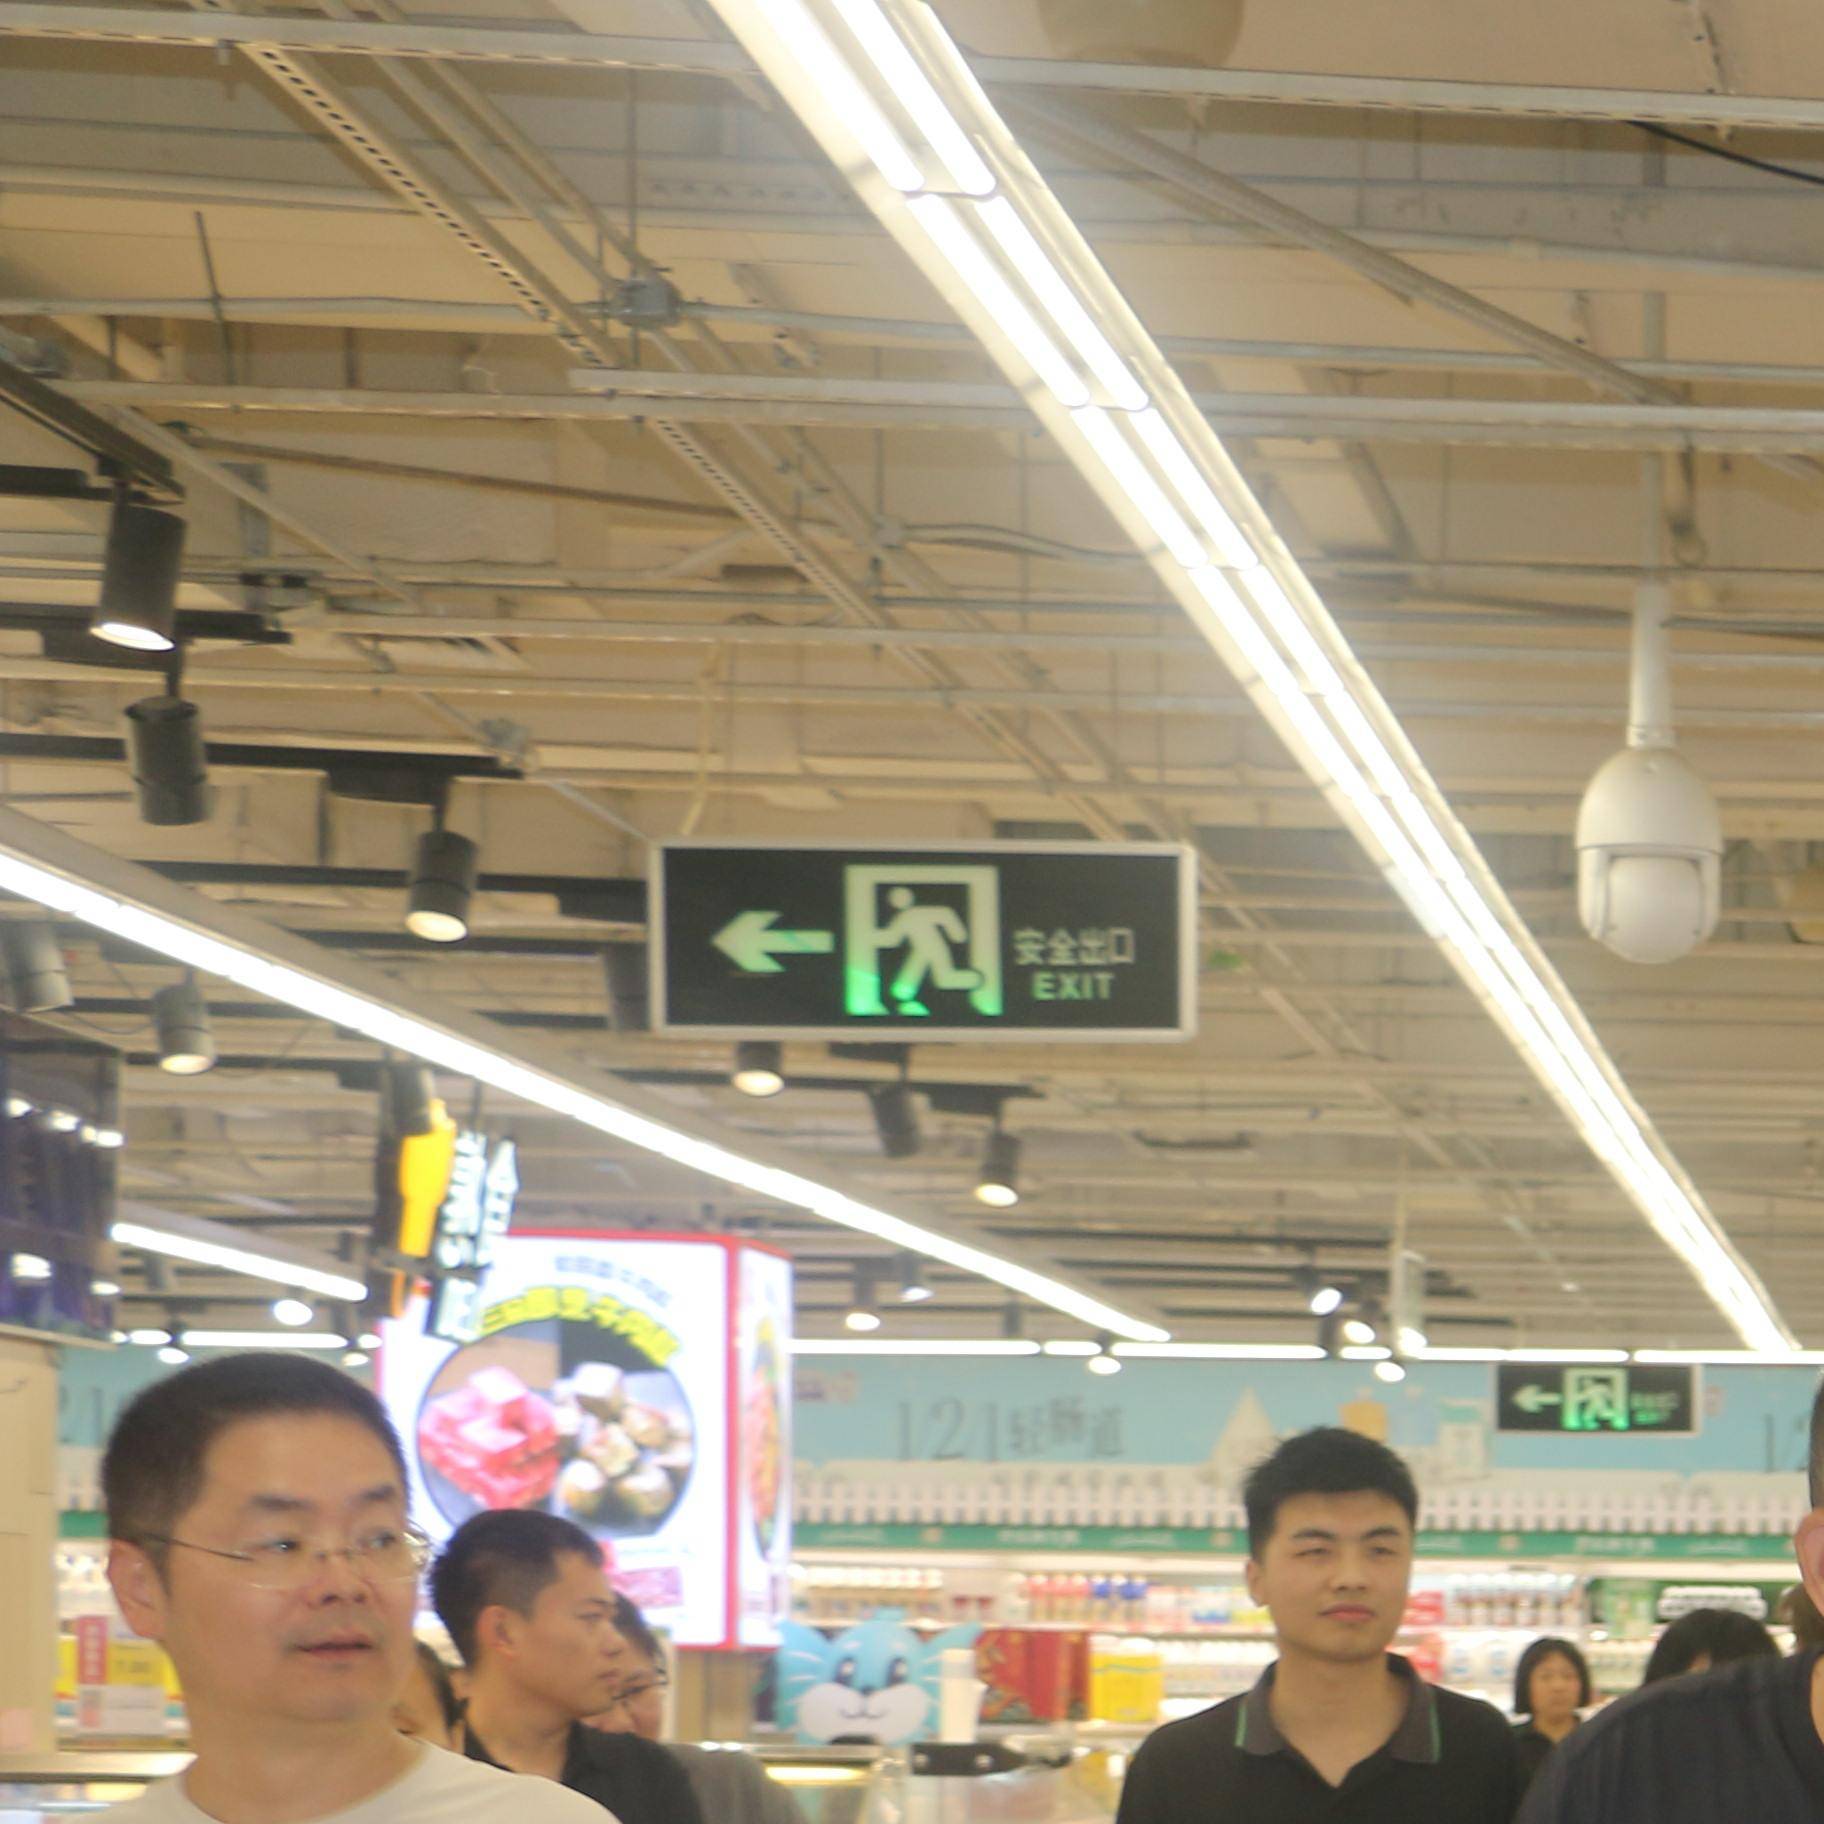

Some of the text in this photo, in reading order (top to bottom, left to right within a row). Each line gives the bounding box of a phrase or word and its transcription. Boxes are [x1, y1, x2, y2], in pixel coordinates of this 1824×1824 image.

[1012, 926, 1136, 966] 安全出口
[1032, 970, 1114, 1000] EXIT
